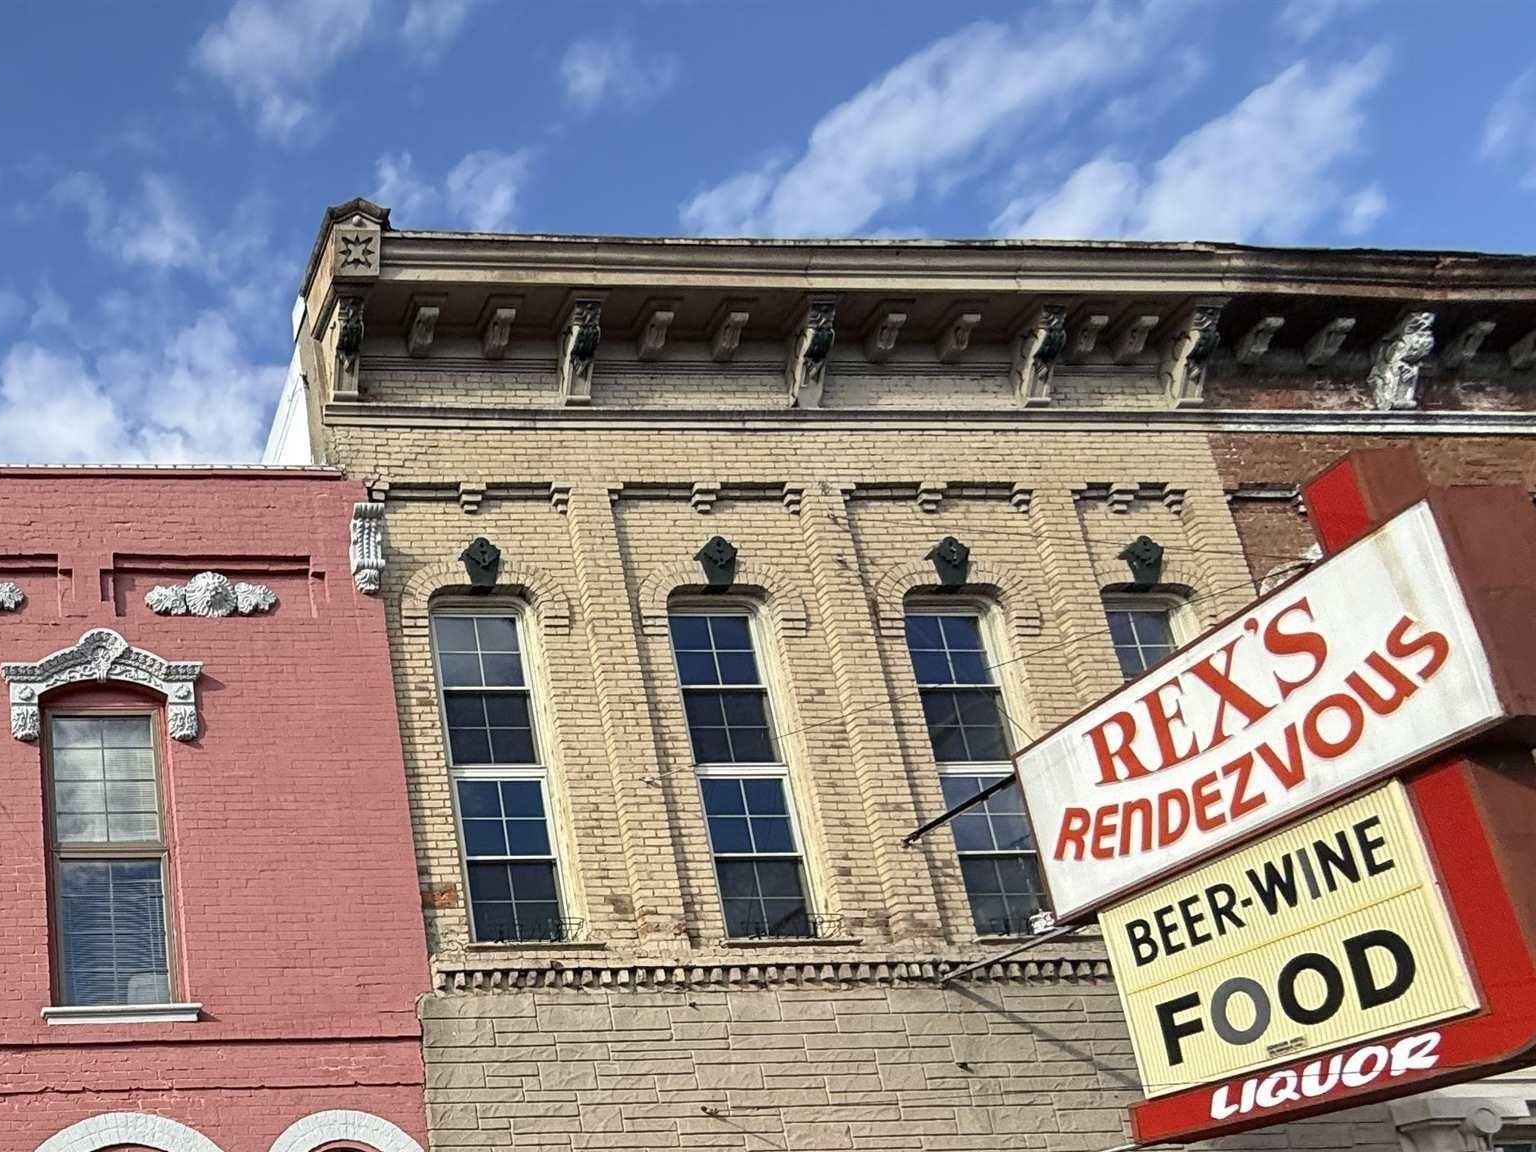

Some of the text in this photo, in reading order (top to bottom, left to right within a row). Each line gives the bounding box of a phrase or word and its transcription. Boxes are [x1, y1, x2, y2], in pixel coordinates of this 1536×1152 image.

[1053, 614, 1450, 862] RENDEZVOUS
[1081, 596, 1328, 787] REX'S
[1125, 815, 1396, 968] BEER-WINE
[1155, 929, 1416, 1067] FOOD
[1211, 1031, 1442, 1120] LIQUOR
